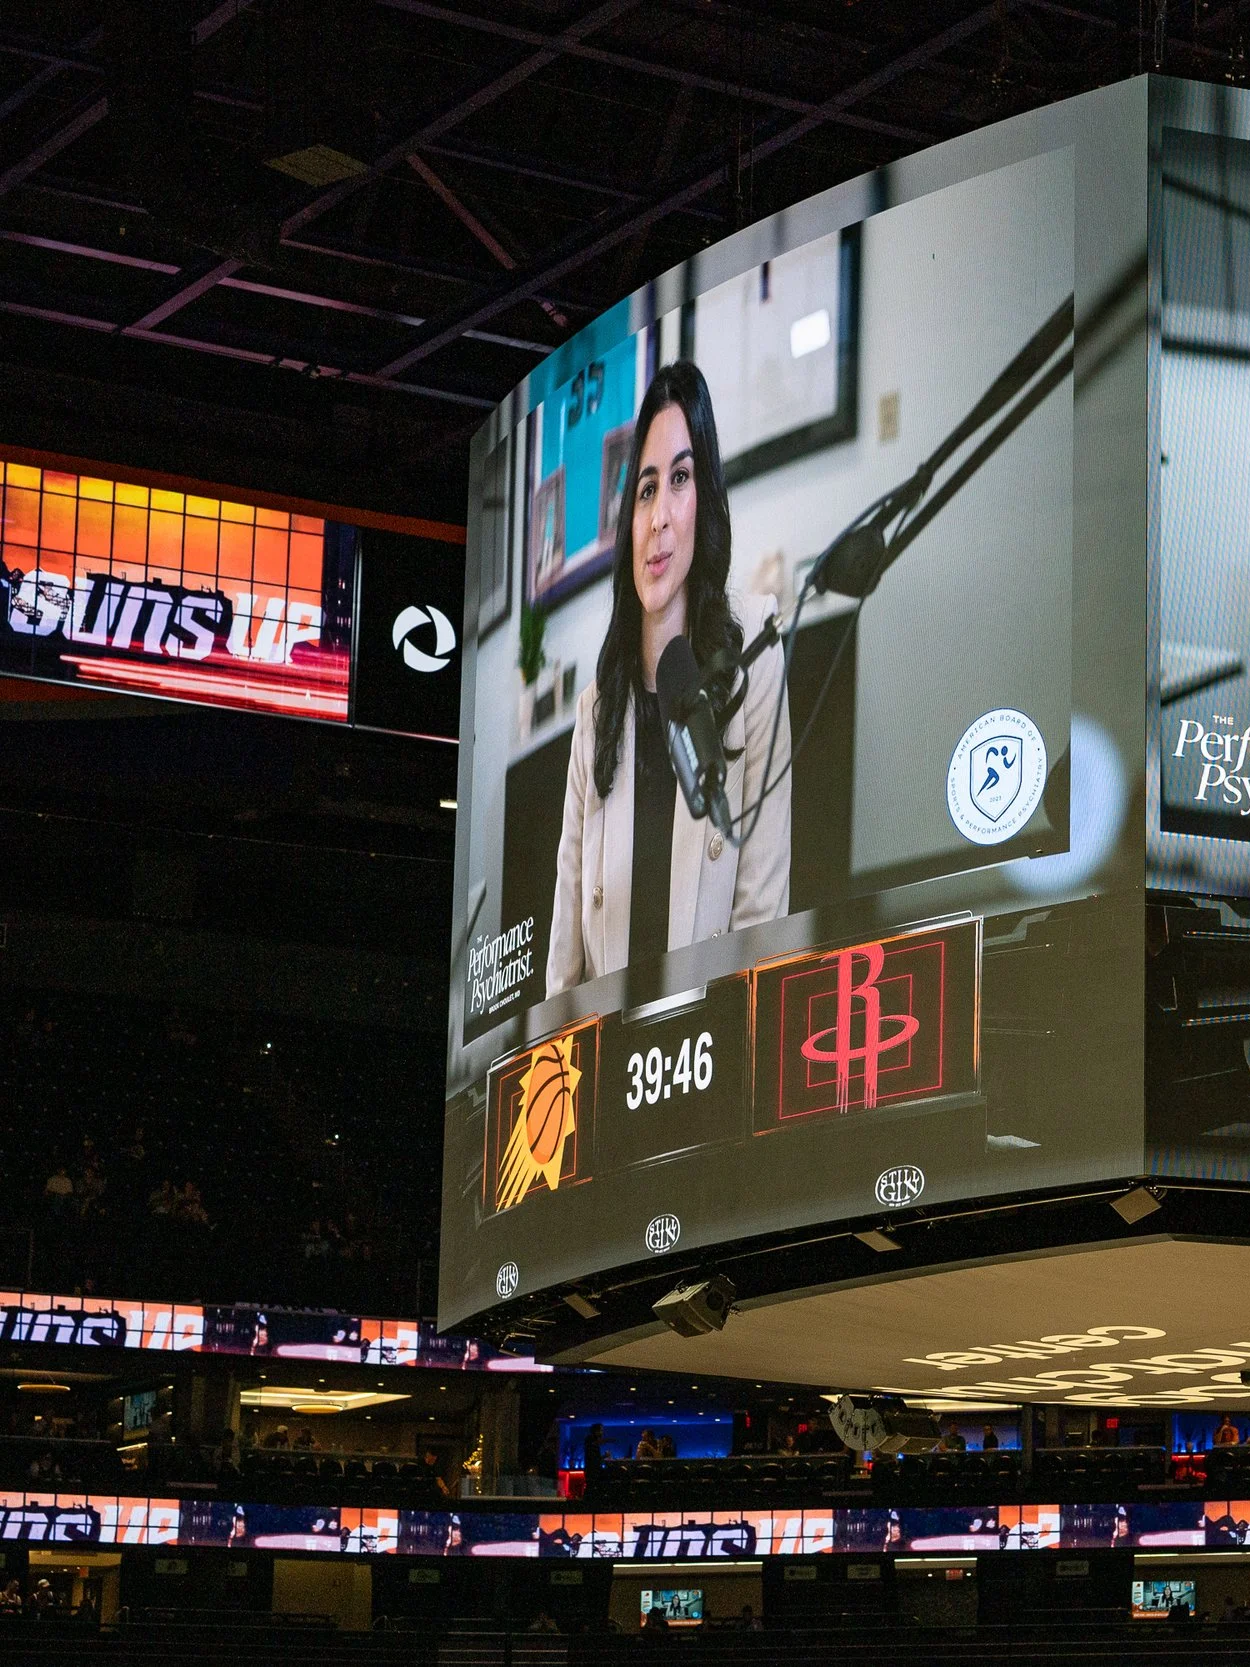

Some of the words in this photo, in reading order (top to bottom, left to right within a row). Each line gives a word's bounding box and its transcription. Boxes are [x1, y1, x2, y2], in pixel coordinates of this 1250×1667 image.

[1212, 715, 1234, 726] THE
[958, 716, 996, 760] AMERICAN
[999, 714, 1027, 729] BOARD
[965, 817, 1017, 835] PERFORMANCE
[467, 916, 534, 982] Performance
[470, 947, 534, 1015] Psychiatrist.
[626, 1031, 713, 1110] 39:46
[881, 1169, 920, 1185] STILL
[879, 1180, 918, 1203] GIN
[650, 1217, 678, 1233] STILL
[649, 1228, 677, 1248] GIN
[903, 1324, 1168, 1372] center
